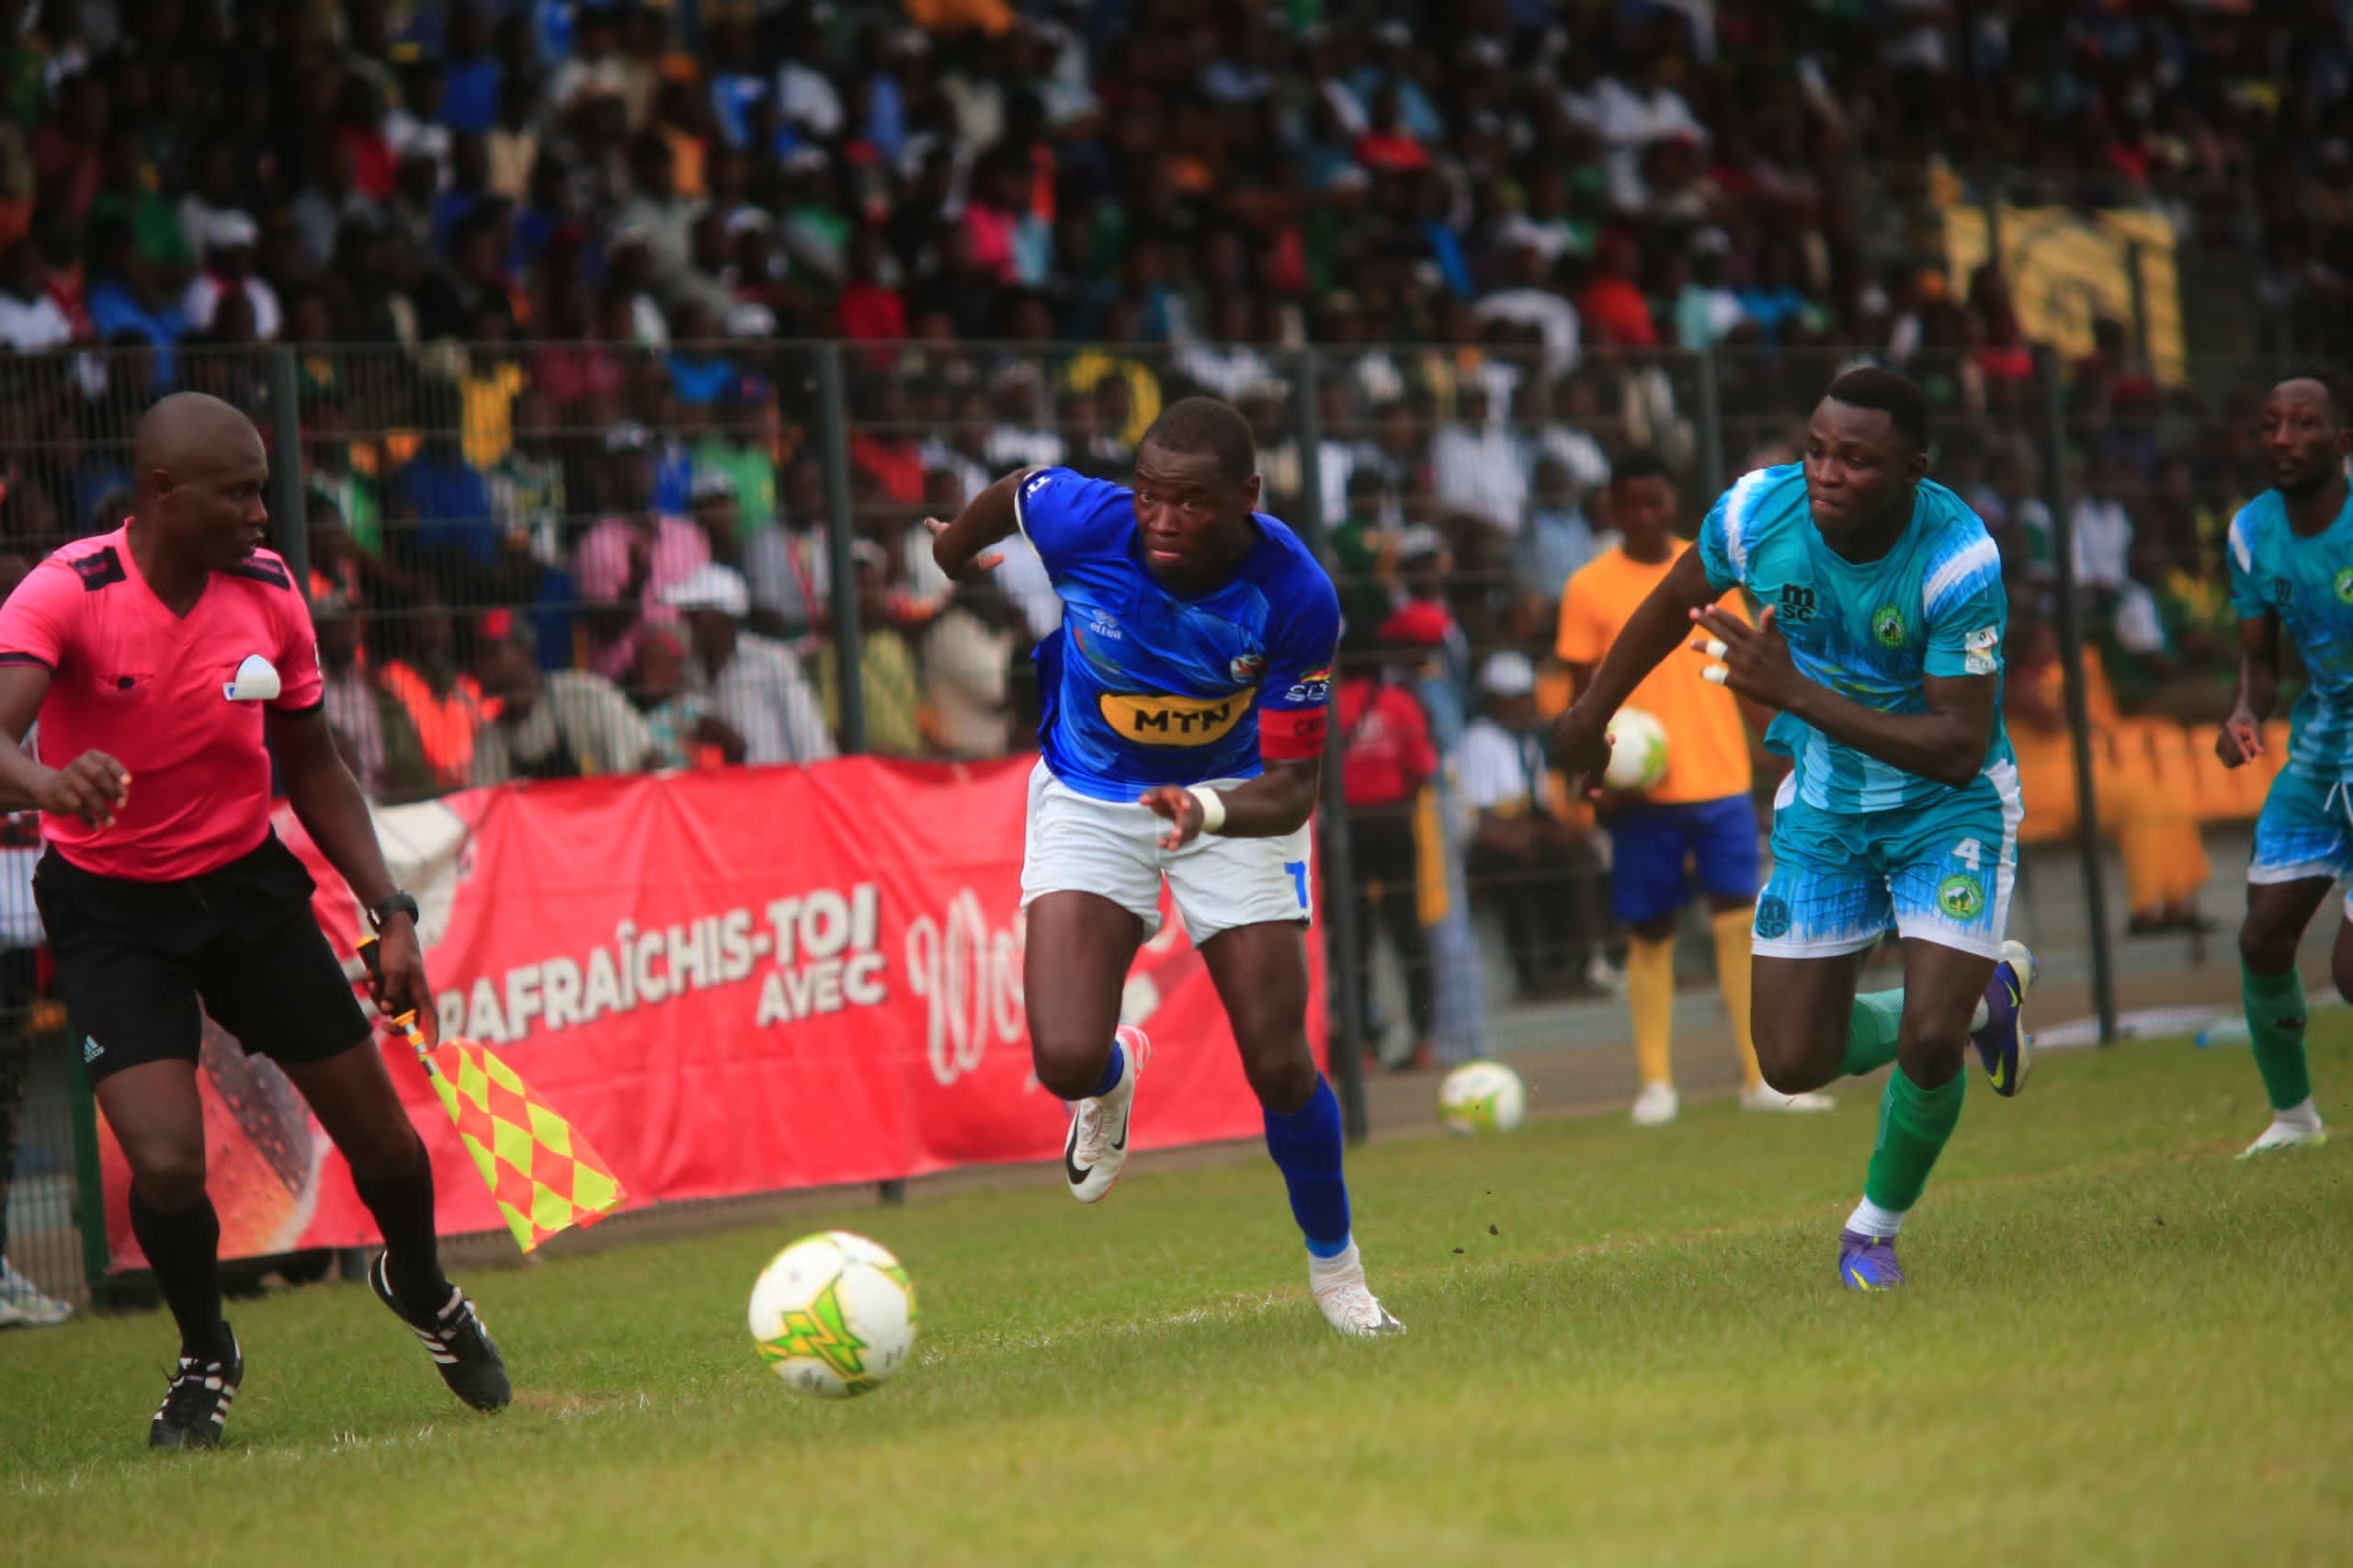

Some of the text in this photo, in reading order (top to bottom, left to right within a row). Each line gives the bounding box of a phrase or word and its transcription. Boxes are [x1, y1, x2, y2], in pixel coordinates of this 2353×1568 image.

[1134, 703, 1230, 733] MTN
[1952, 837, 1981, 870] 4
[1283, 860, 1308, 909] 7
[438, 882, 881, 1046] RAFRAÎCHIS-TOI
[756, 951, 887, 1028] AVEC
